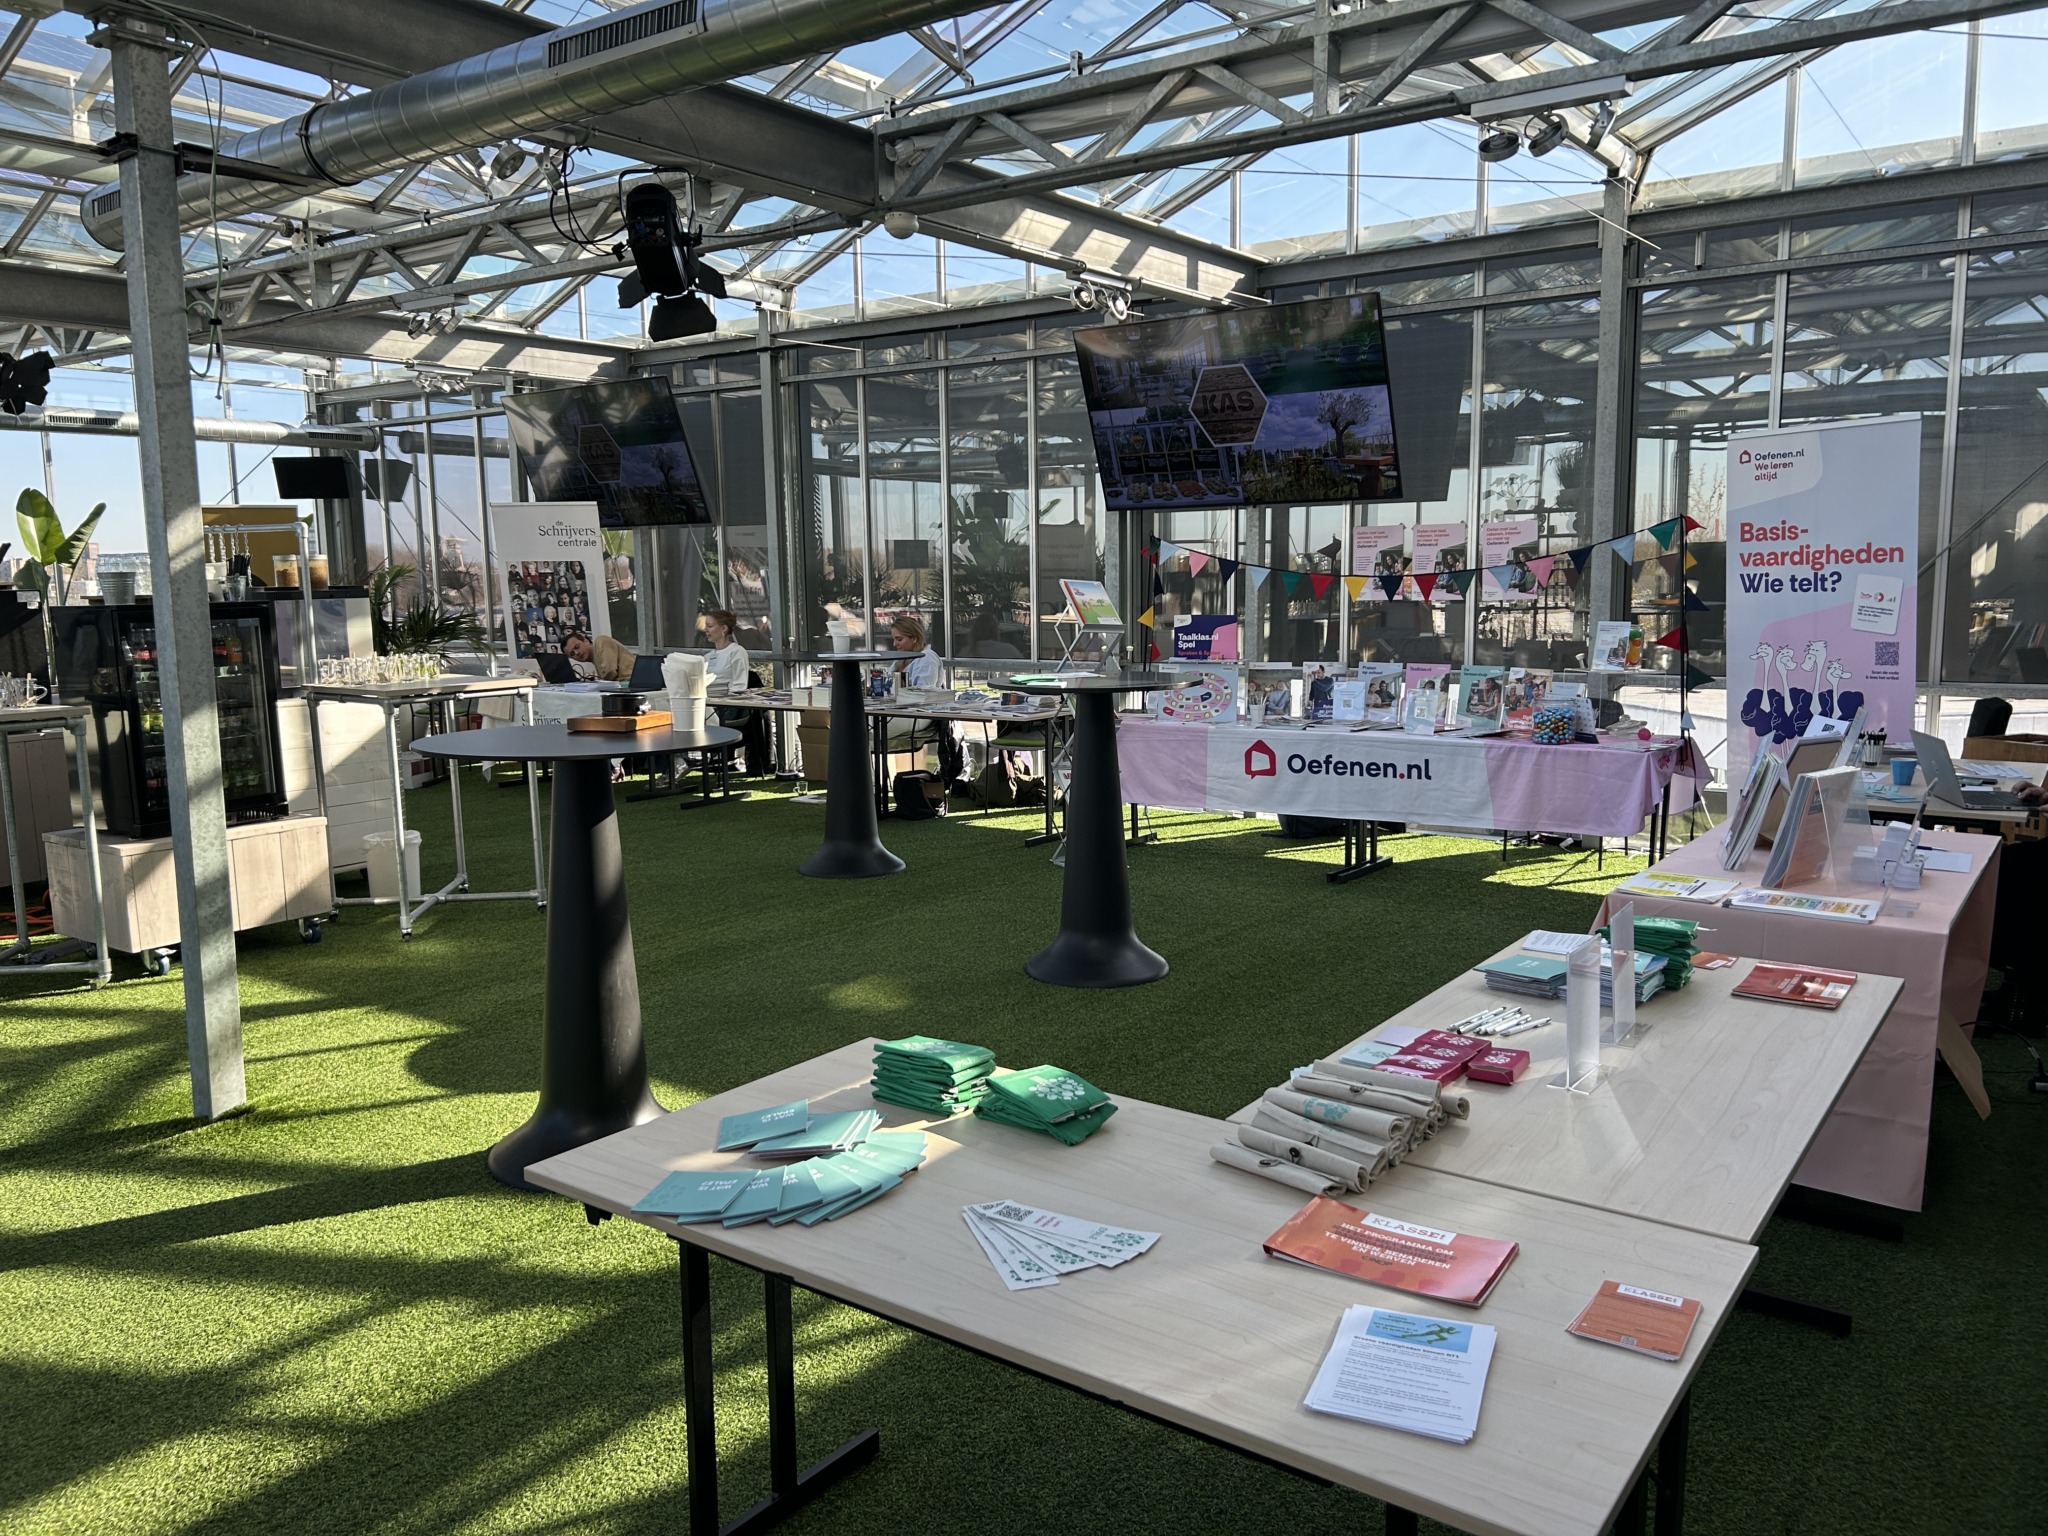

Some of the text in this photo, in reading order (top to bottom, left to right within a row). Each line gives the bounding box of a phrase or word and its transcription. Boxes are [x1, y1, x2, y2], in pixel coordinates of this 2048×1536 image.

[1202, 391, 1255, 415] KAS
[1754, 449, 1804, 461] Oefenen.nl
[1754, 462, 1794, 471] We leren
[1754, 472, 1778, 482] altijd
[538, 524, 596, 539] Schrijvers
[1740, 520, 1808, 542] Basis-
[558, 538, 597, 547] centrale
[1739, 542, 1904, 571] vaardigheden
[1740, 571, 1842, 593] Wie telt?
[1287, 754, 1432, 780] Oefenen.nl
[1372, 1217, 1446, 1241] KLASSE!
[1340, 1222, 1455, 1256] HET PROGRAMMA OM
[1352, 1246, 1416, 1266] EN WERVEN
[1362, 1256, 1394, 1266] CINOP
[1384, 1250, 1451, 1269] BENADEREN
[1624, 1287, 1677, 1303] KLASSE!
[1378, 1340, 1421, 1352] vaardigheden
[1423, 1348, 1445, 1356] binnen
